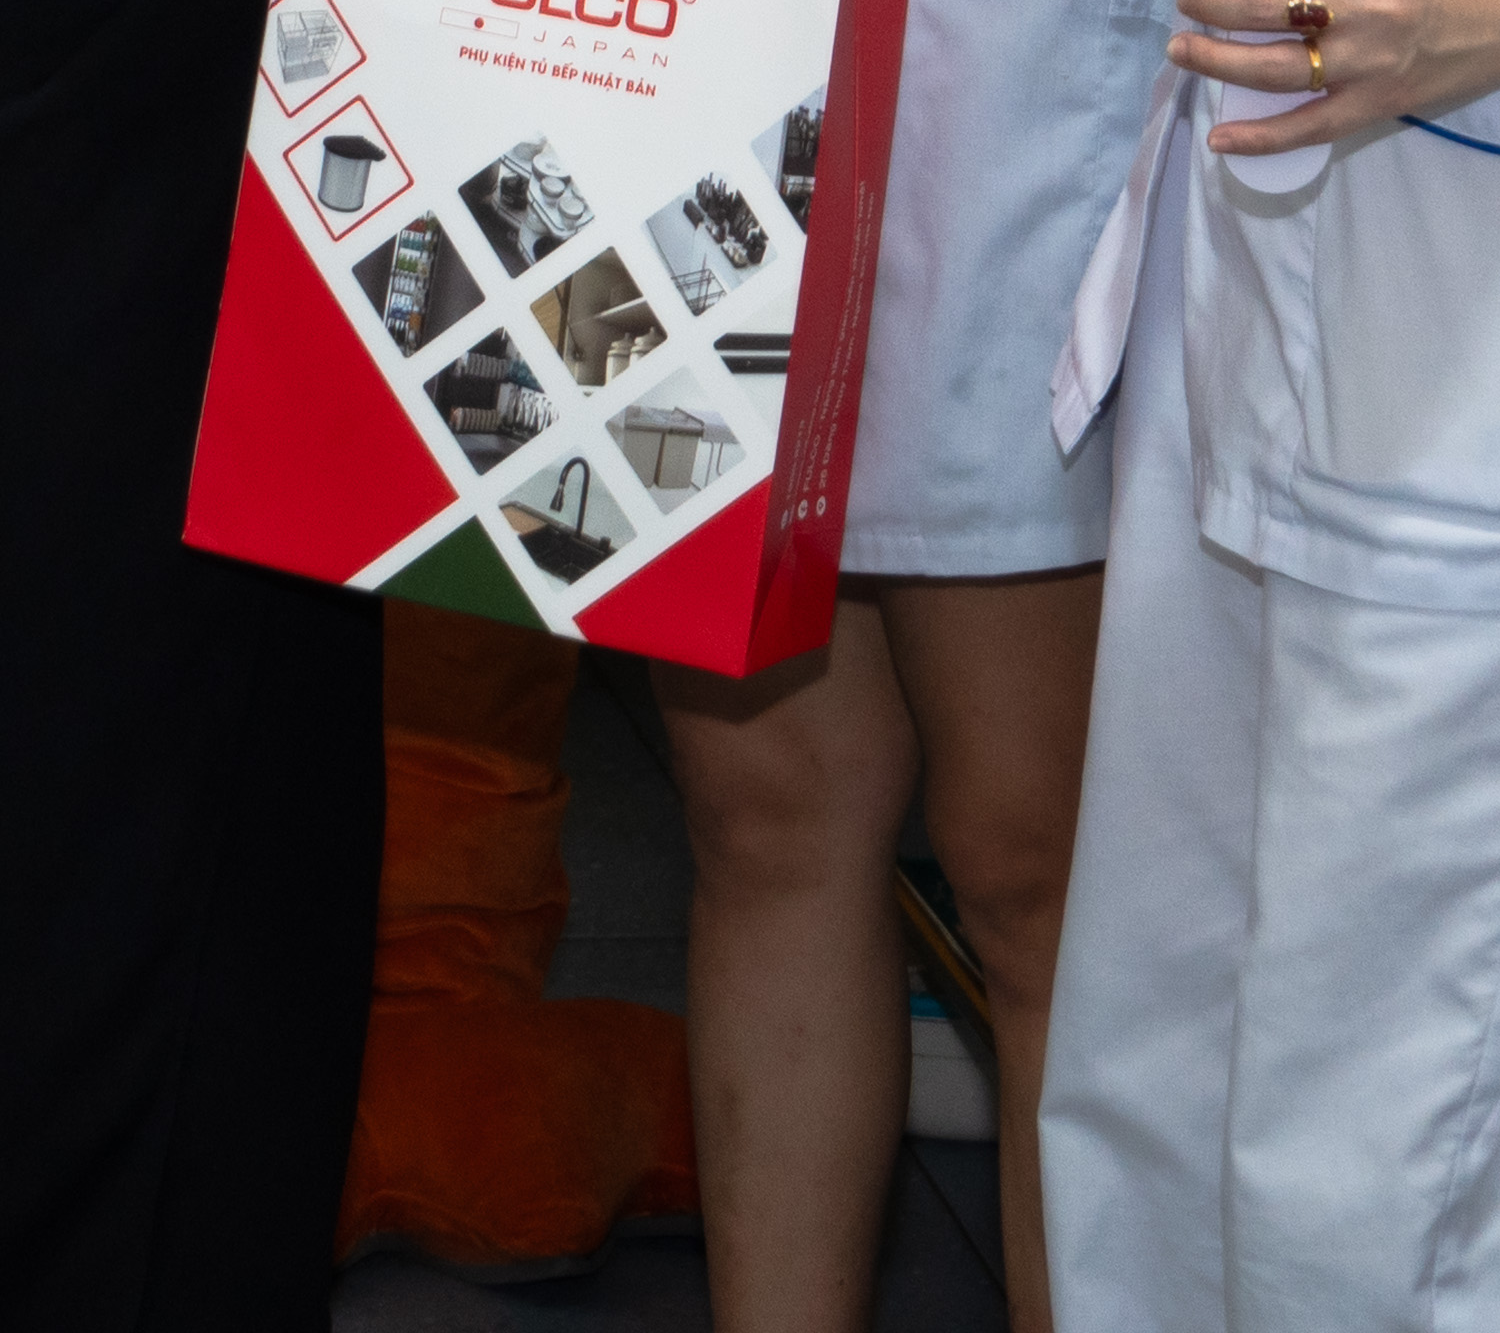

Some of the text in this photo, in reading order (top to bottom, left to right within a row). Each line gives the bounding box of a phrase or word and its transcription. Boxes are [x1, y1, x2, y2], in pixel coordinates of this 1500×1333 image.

[458, 45, 657, 98] PHỤ KIỆN TỦ BẾP NHẬT BẢN
[533, 30, 670, 68] JAPAN
